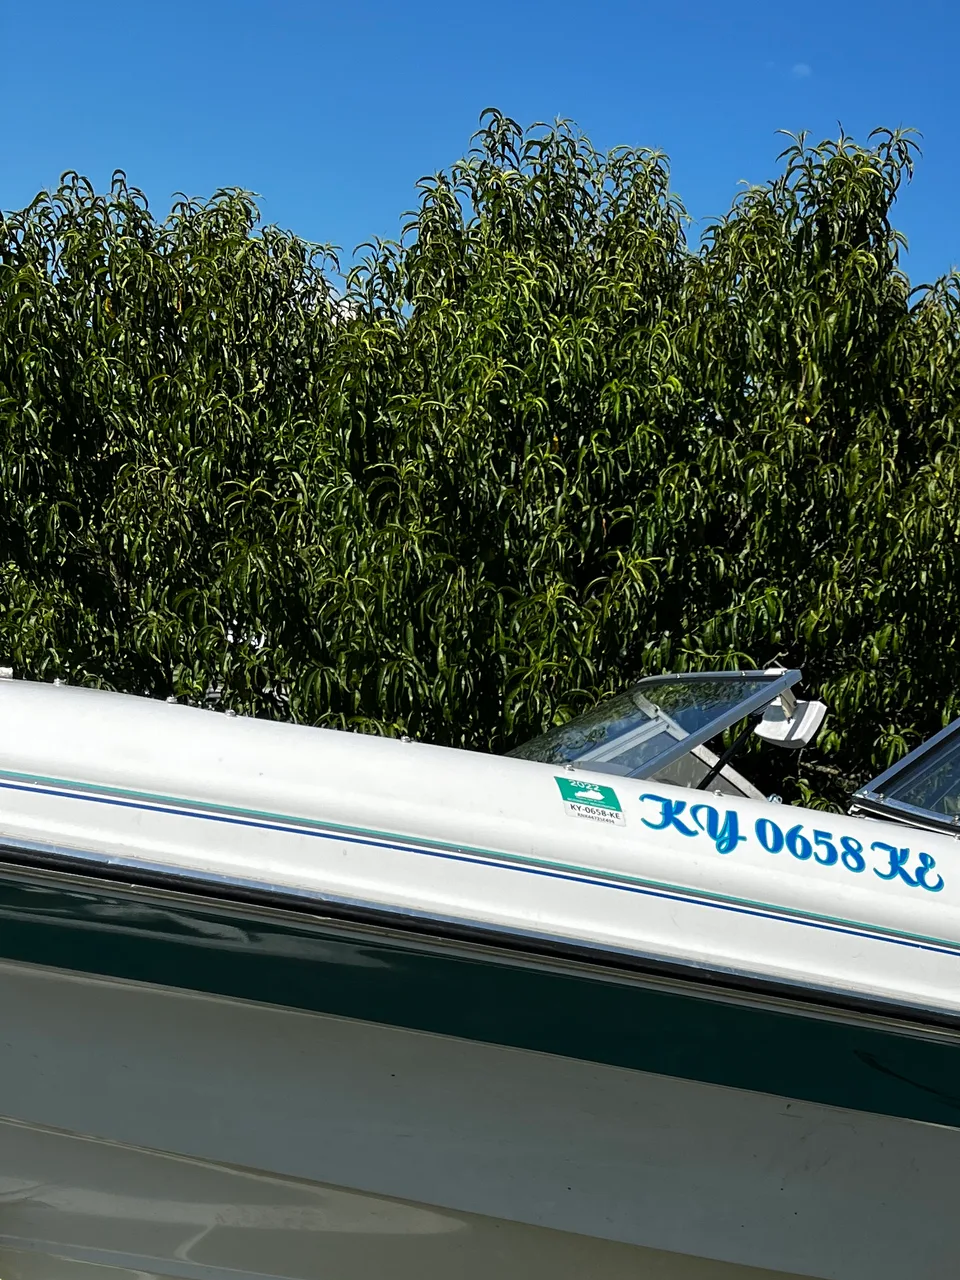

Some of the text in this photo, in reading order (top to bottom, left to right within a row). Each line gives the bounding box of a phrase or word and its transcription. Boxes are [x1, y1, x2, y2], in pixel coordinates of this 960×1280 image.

[568, 780, 602, 792] 2022
[570, 803, 621, 820] KY-0658-KE
[639, 793, 945, 893] KY 0658 KE
